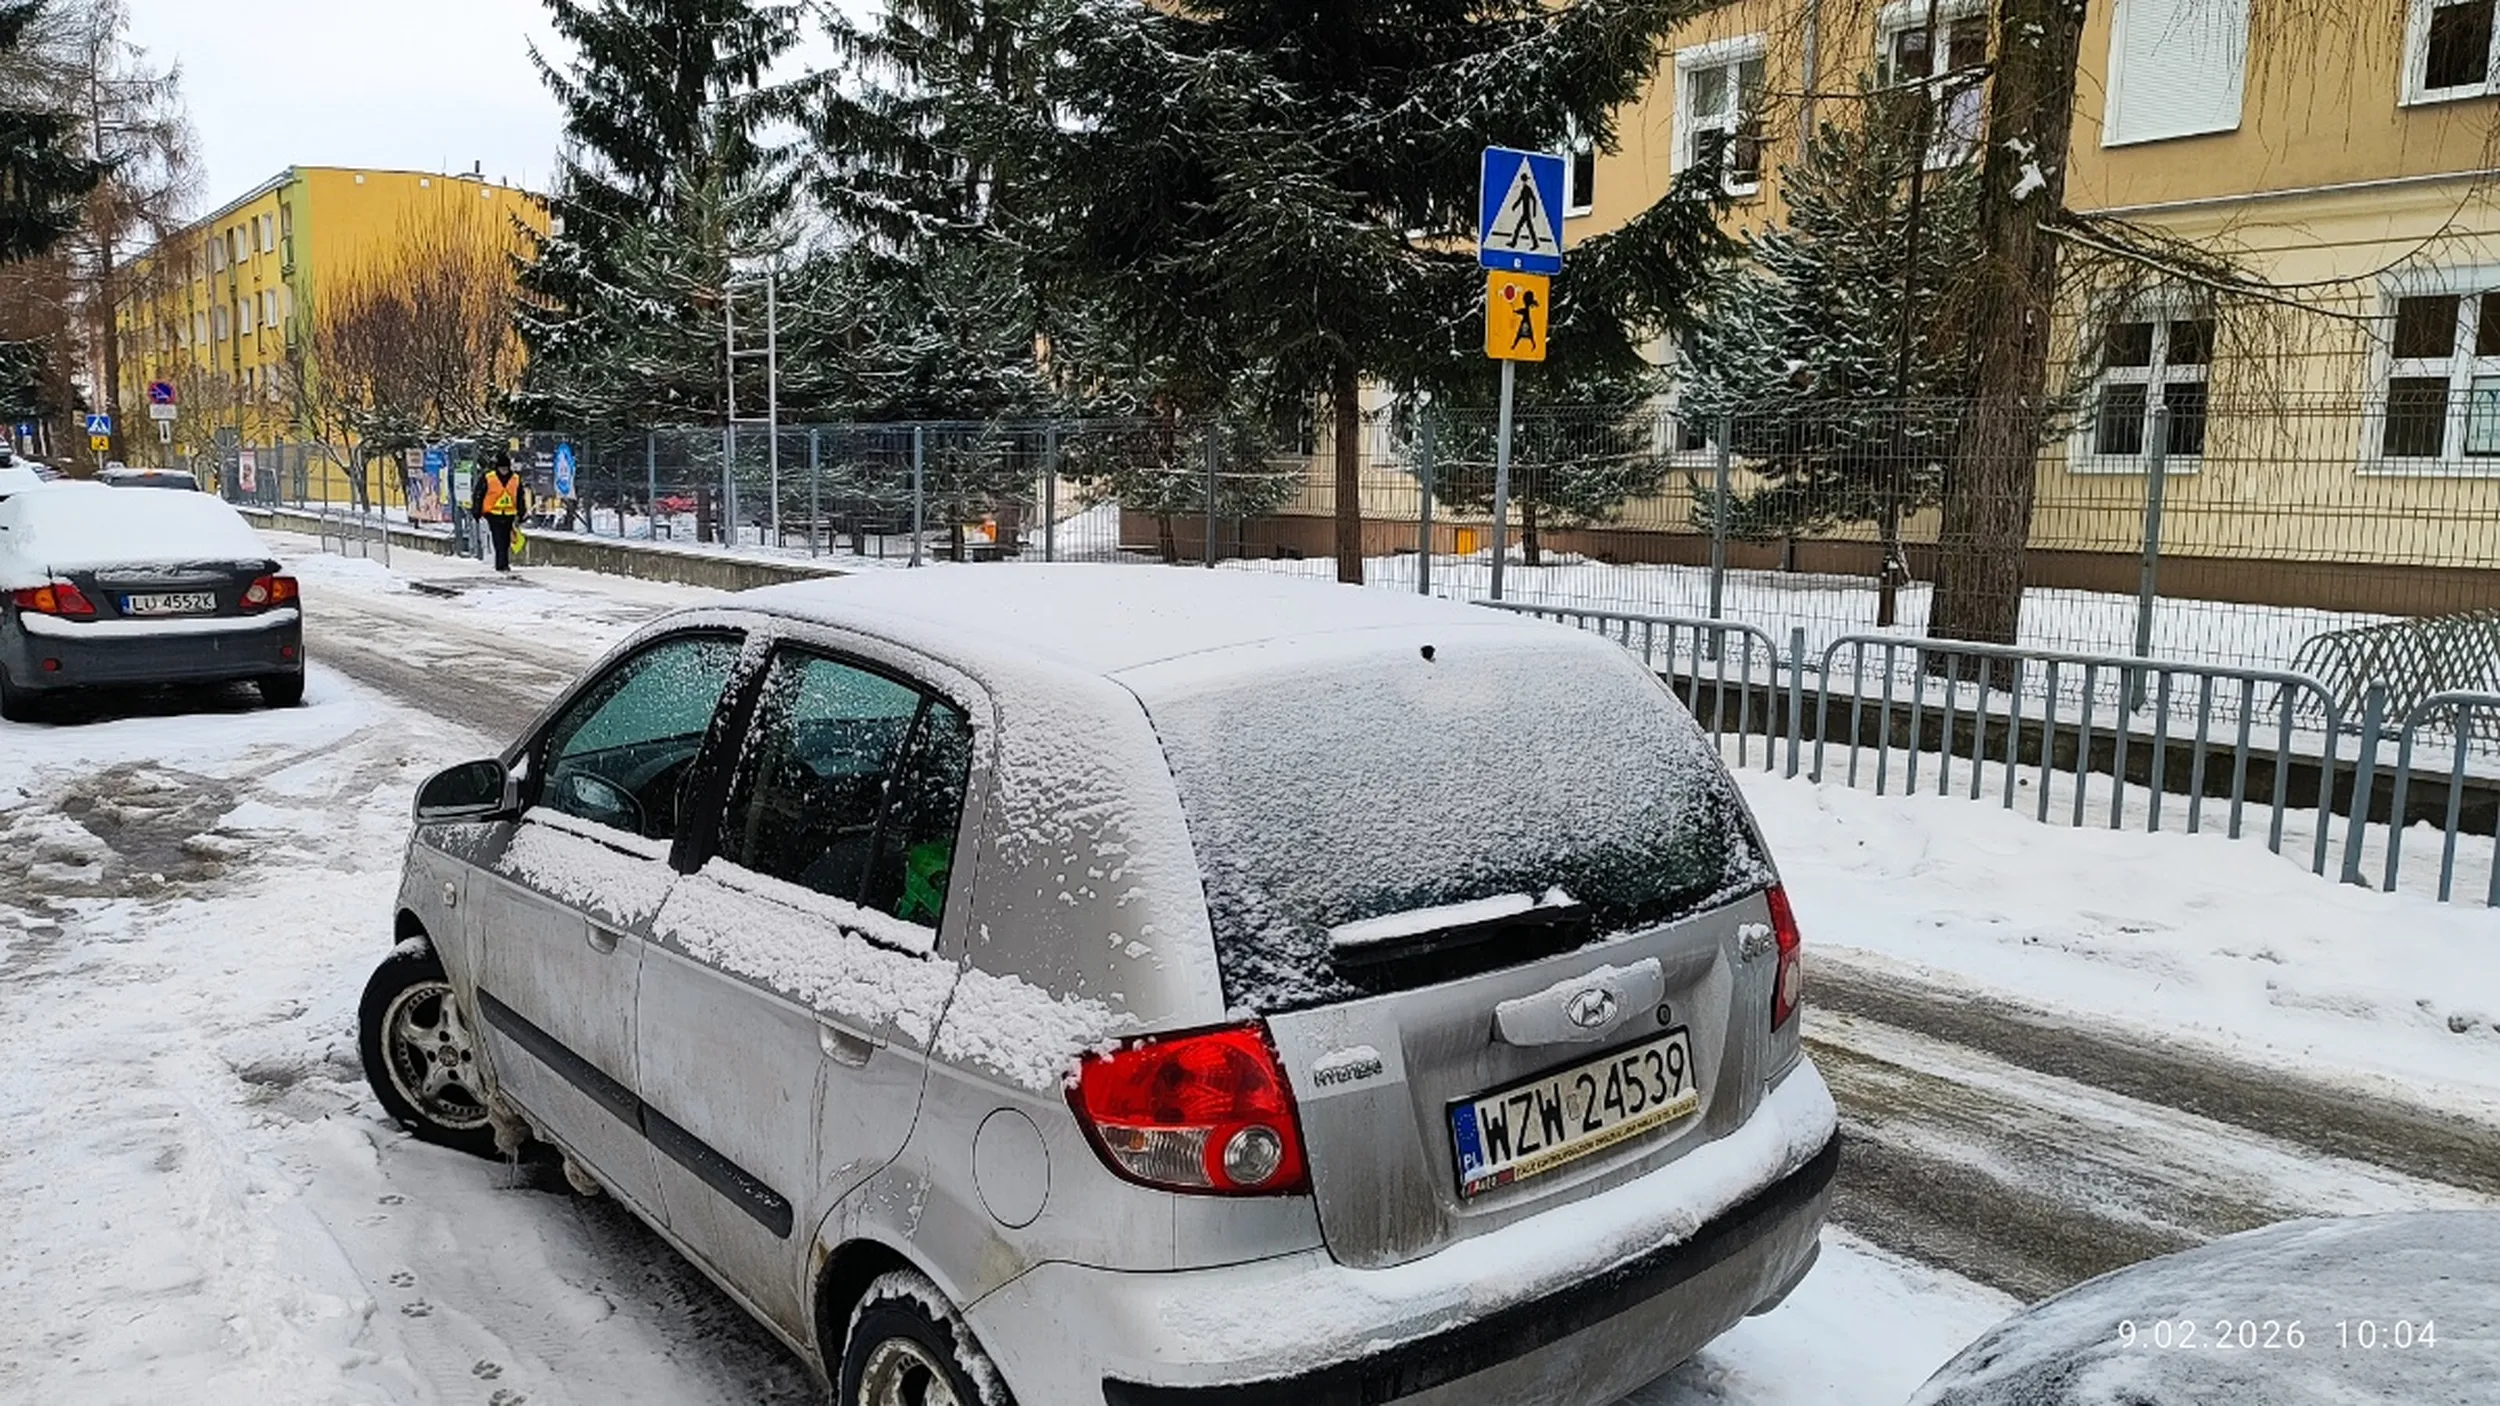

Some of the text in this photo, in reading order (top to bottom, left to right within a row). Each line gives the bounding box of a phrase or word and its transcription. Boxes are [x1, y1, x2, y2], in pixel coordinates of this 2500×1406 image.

[132, 597, 157, 612] LU
[1481, 1082, 1566, 1166] WZW
[1575, 1041, 1685, 1133] 24539
